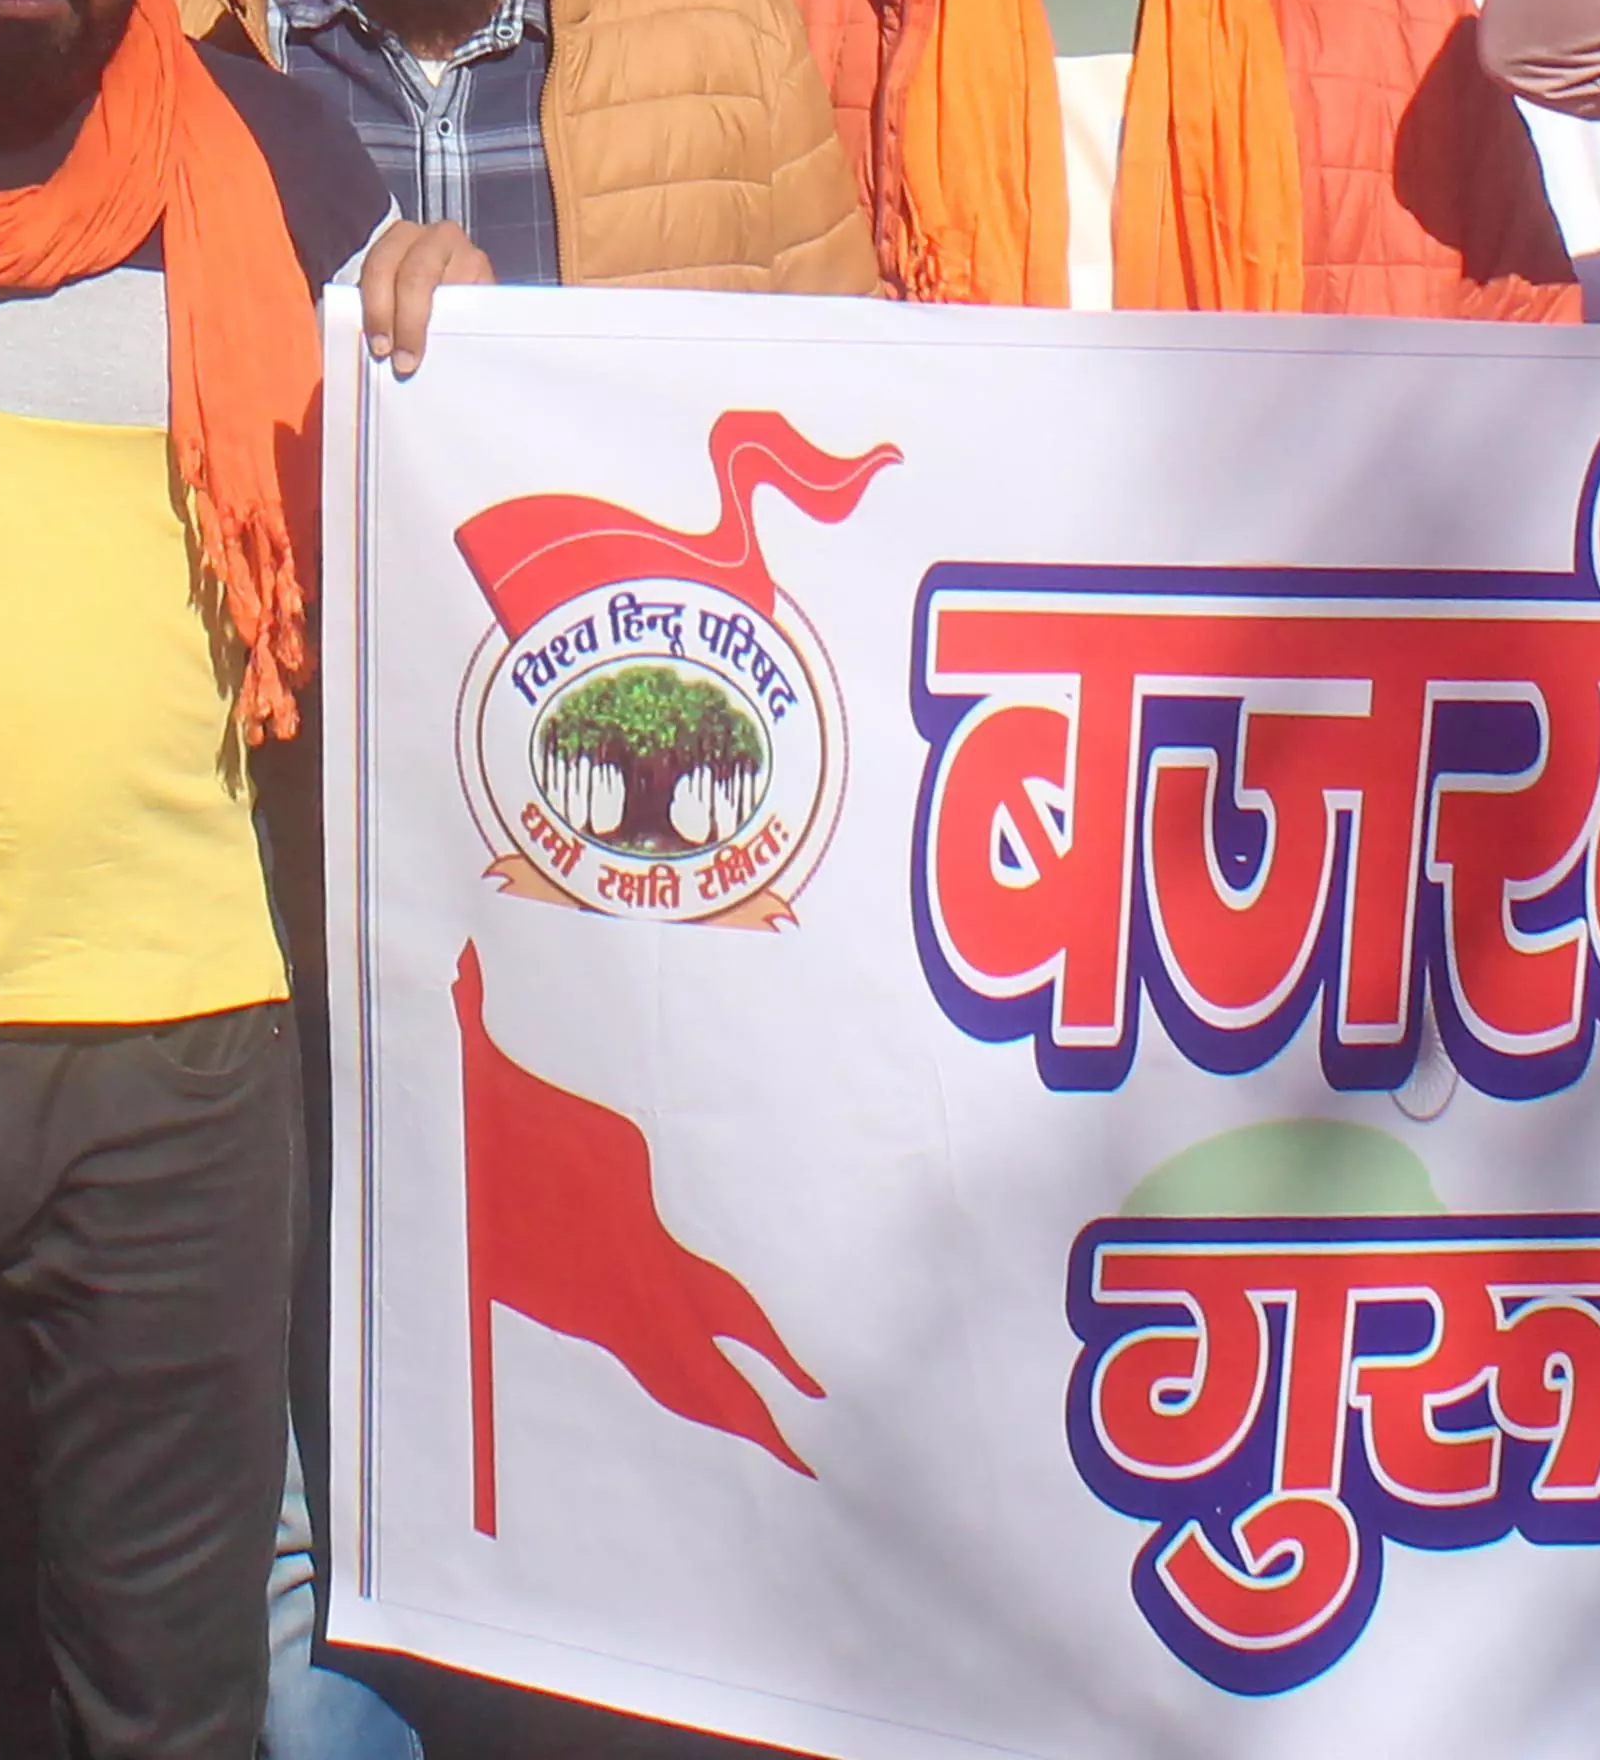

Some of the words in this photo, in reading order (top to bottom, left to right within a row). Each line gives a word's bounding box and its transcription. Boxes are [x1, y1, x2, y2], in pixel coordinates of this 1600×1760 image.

[511, 615, 599, 706] विश्व
[607, 591, 686, 659] हिन्दू
[698, 608, 798, 723] परिषद
[597, 863, 681, 909] रक्षति
[694, 813, 790, 901] रक्षितः
